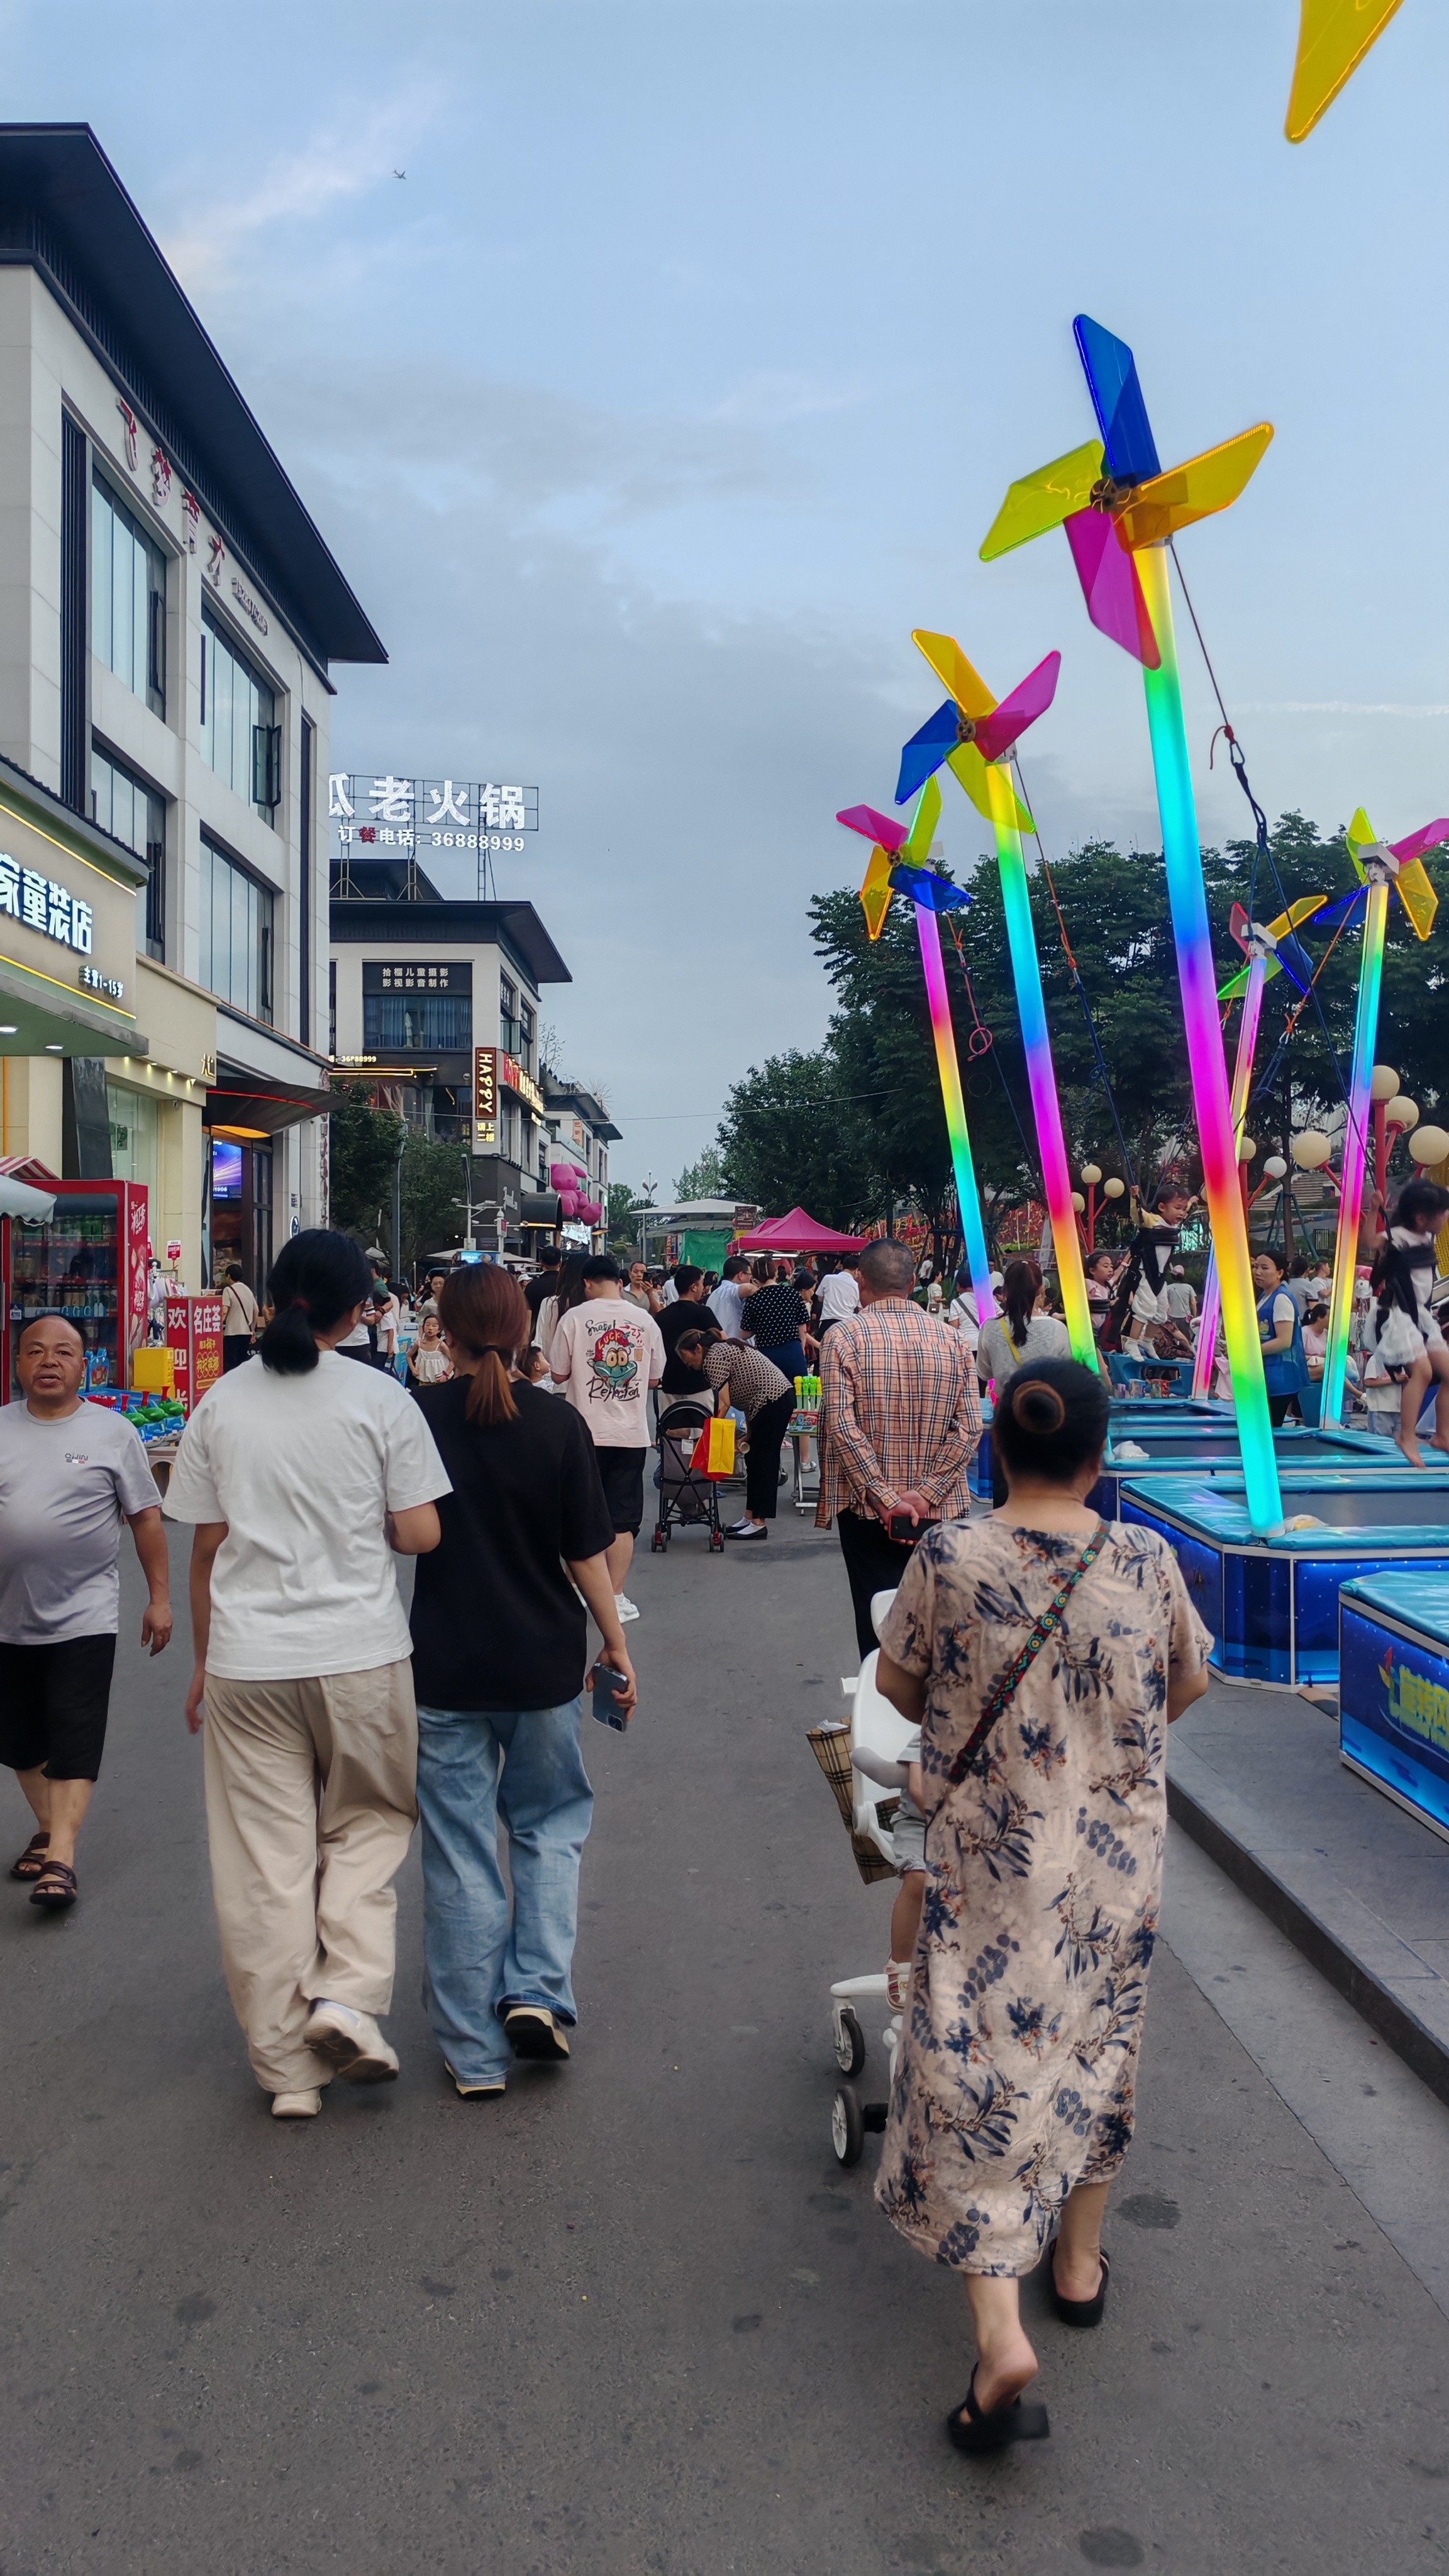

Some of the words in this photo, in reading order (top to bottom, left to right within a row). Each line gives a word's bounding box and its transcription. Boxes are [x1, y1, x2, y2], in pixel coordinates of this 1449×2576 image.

[479, 1053, 493, 1113] HAPPY
[194, 1305, 221, 1335] 名庄荟
